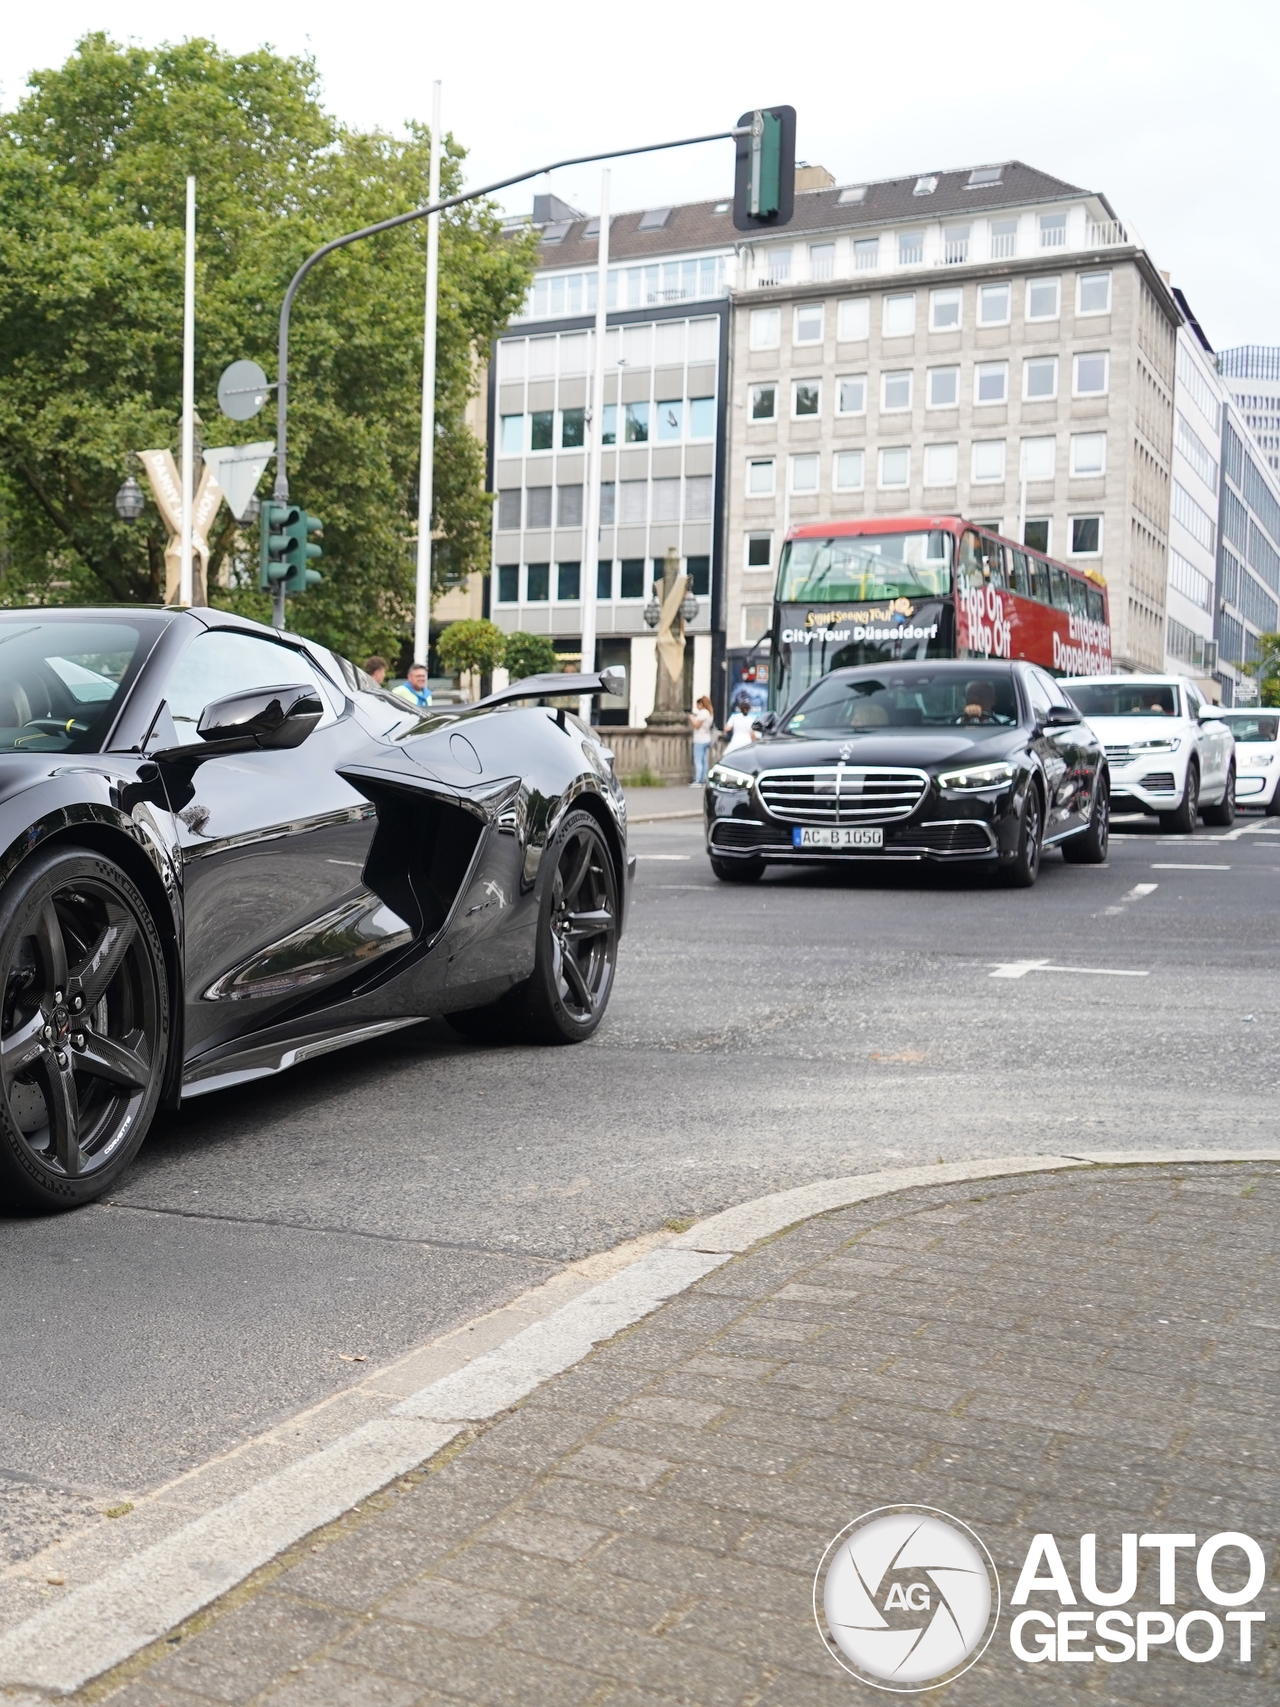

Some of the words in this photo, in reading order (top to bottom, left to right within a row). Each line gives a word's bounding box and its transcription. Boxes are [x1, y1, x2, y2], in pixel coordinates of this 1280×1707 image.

[151, 453, 182, 502] DANNY
[960, 573, 985, 618] Hop
[986, 582, 1003, 622] On
[782, 628, 851, 645] City-Tour
[854, 624, 938, 641] Düsseldorf
[968, 612, 992, 659] Hop
[994, 617, 1011, 658] Off
[1068, 604, 1111, 650] Entdecker
[1053, 631, 1112, 678] Doppeldecker
[803, 830, 820, 844] AC
[831, 831, 840, 844] B
[845, 830, 881, 844] 1050
[104, 1115, 132, 1154] CORVETTE
